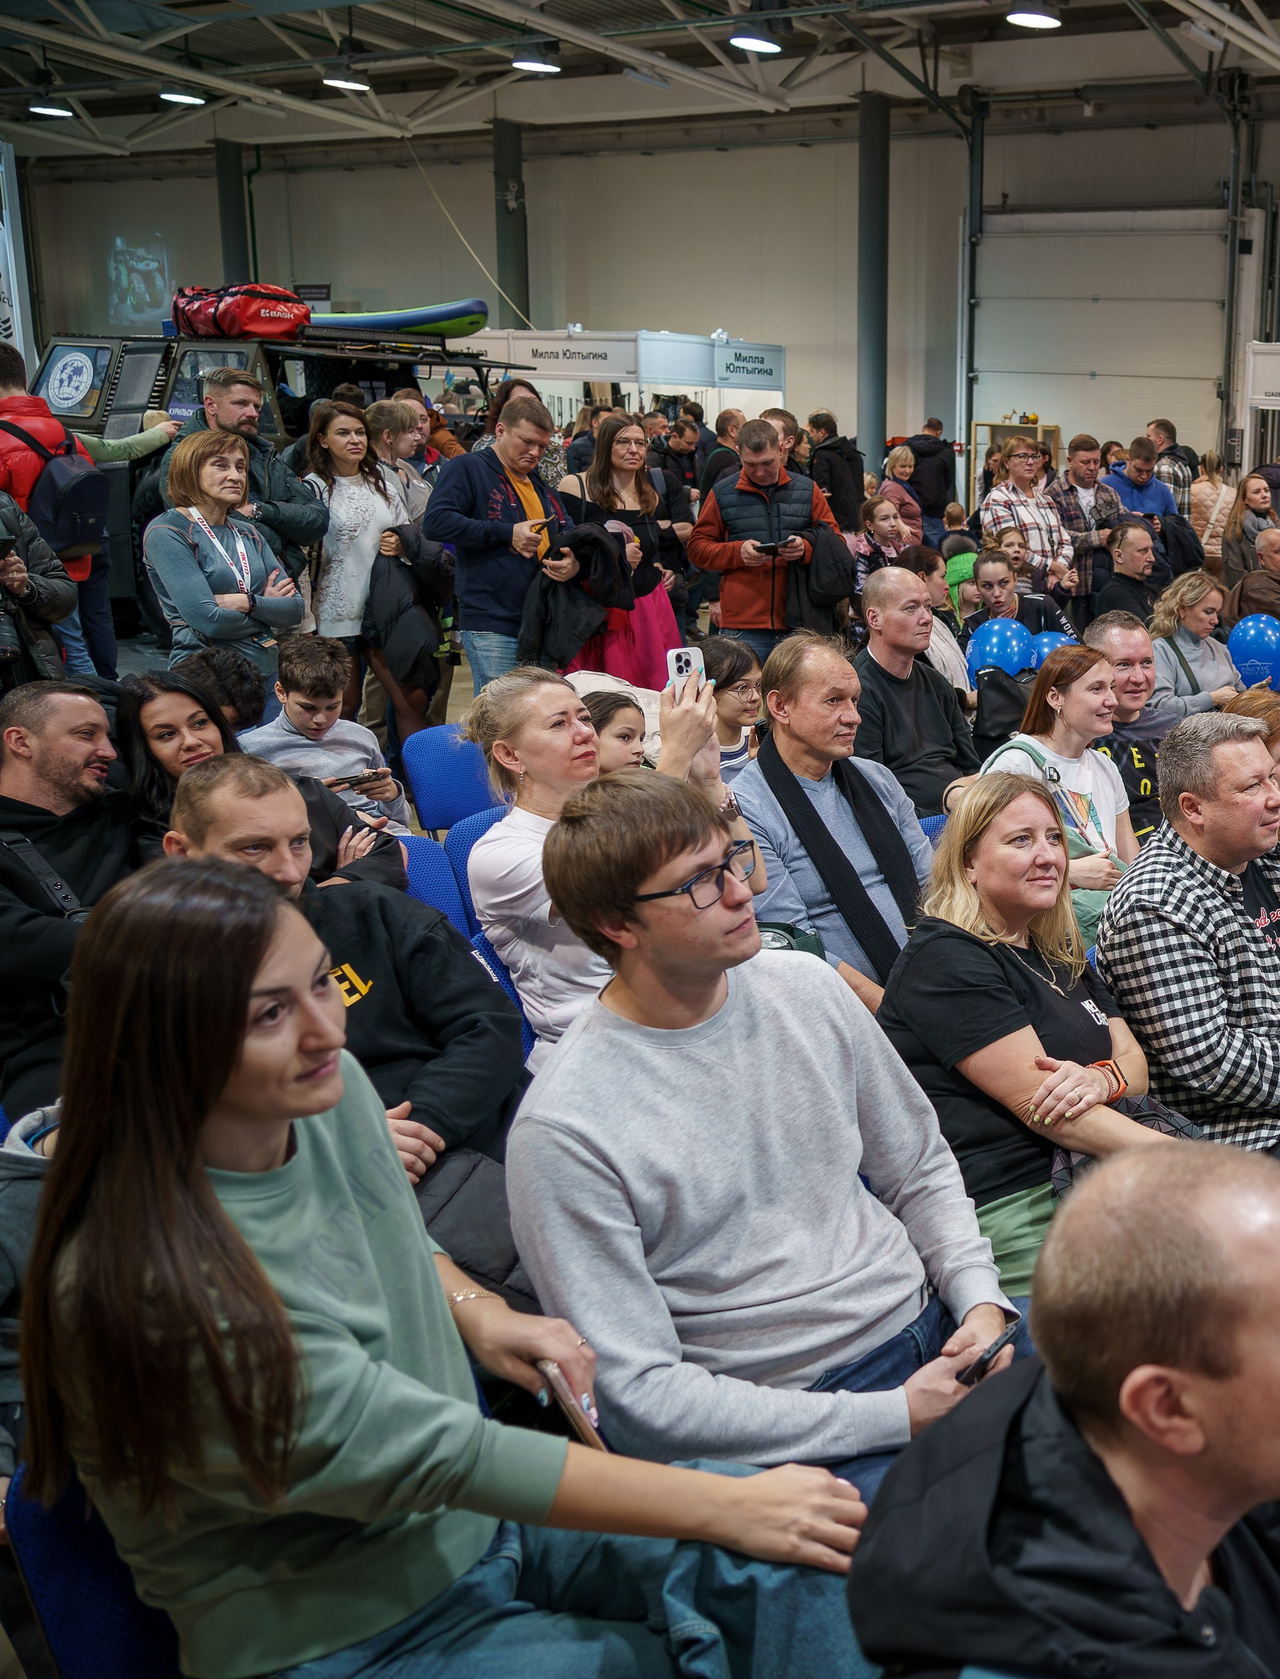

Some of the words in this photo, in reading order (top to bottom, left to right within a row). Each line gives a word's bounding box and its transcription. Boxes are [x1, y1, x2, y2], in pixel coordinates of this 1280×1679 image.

[270, 310, 294, 319] BASK
[531, 348, 559, 360] Милла
[562, 349, 608, 361] Юлтыгина
[734, 352, 765, 365] Милла
[725, 362, 773, 376] Юлтыгина
